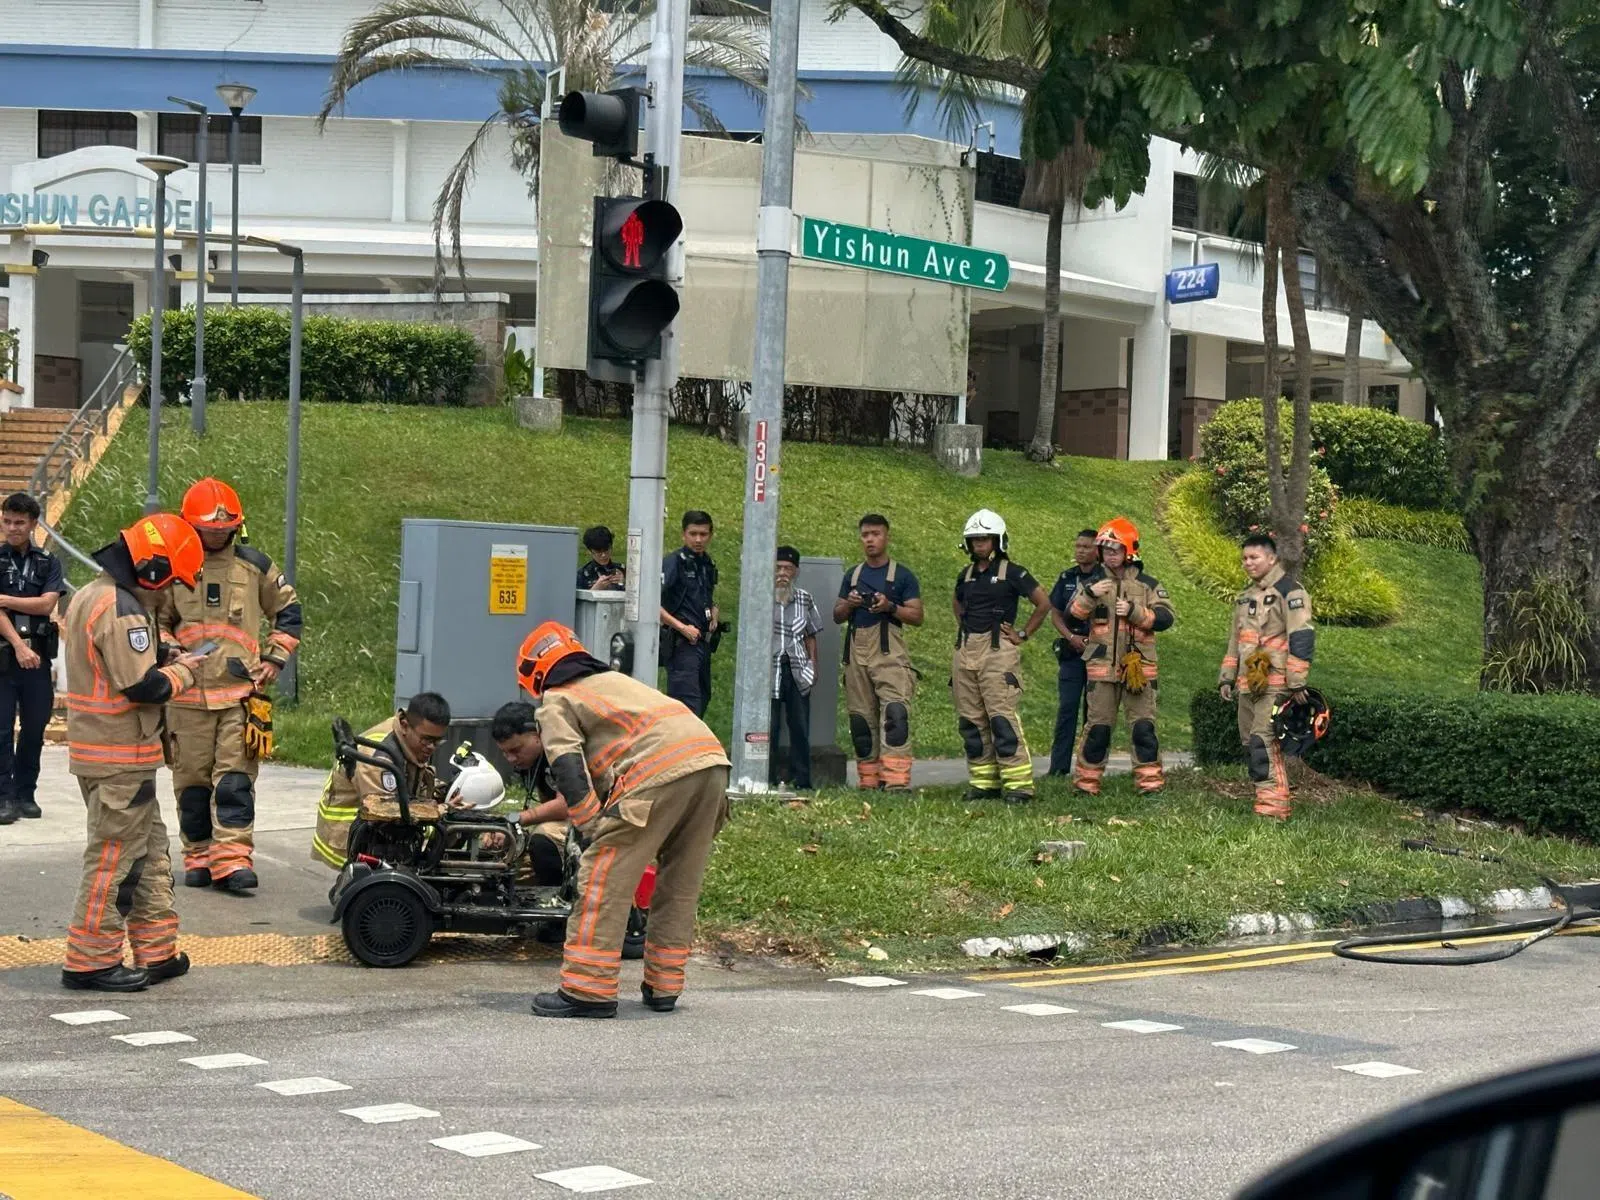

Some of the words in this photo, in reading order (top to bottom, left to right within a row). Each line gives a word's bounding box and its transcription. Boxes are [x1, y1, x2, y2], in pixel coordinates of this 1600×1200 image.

[813, 224, 909, 269] Yishun
[923, 246, 971, 280] Ave
[983, 258, 997, 284] 2
[1177, 269, 1206, 290] 224
[754, 421, 766, 501] 130F
[499, 590, 517, 604] 635
